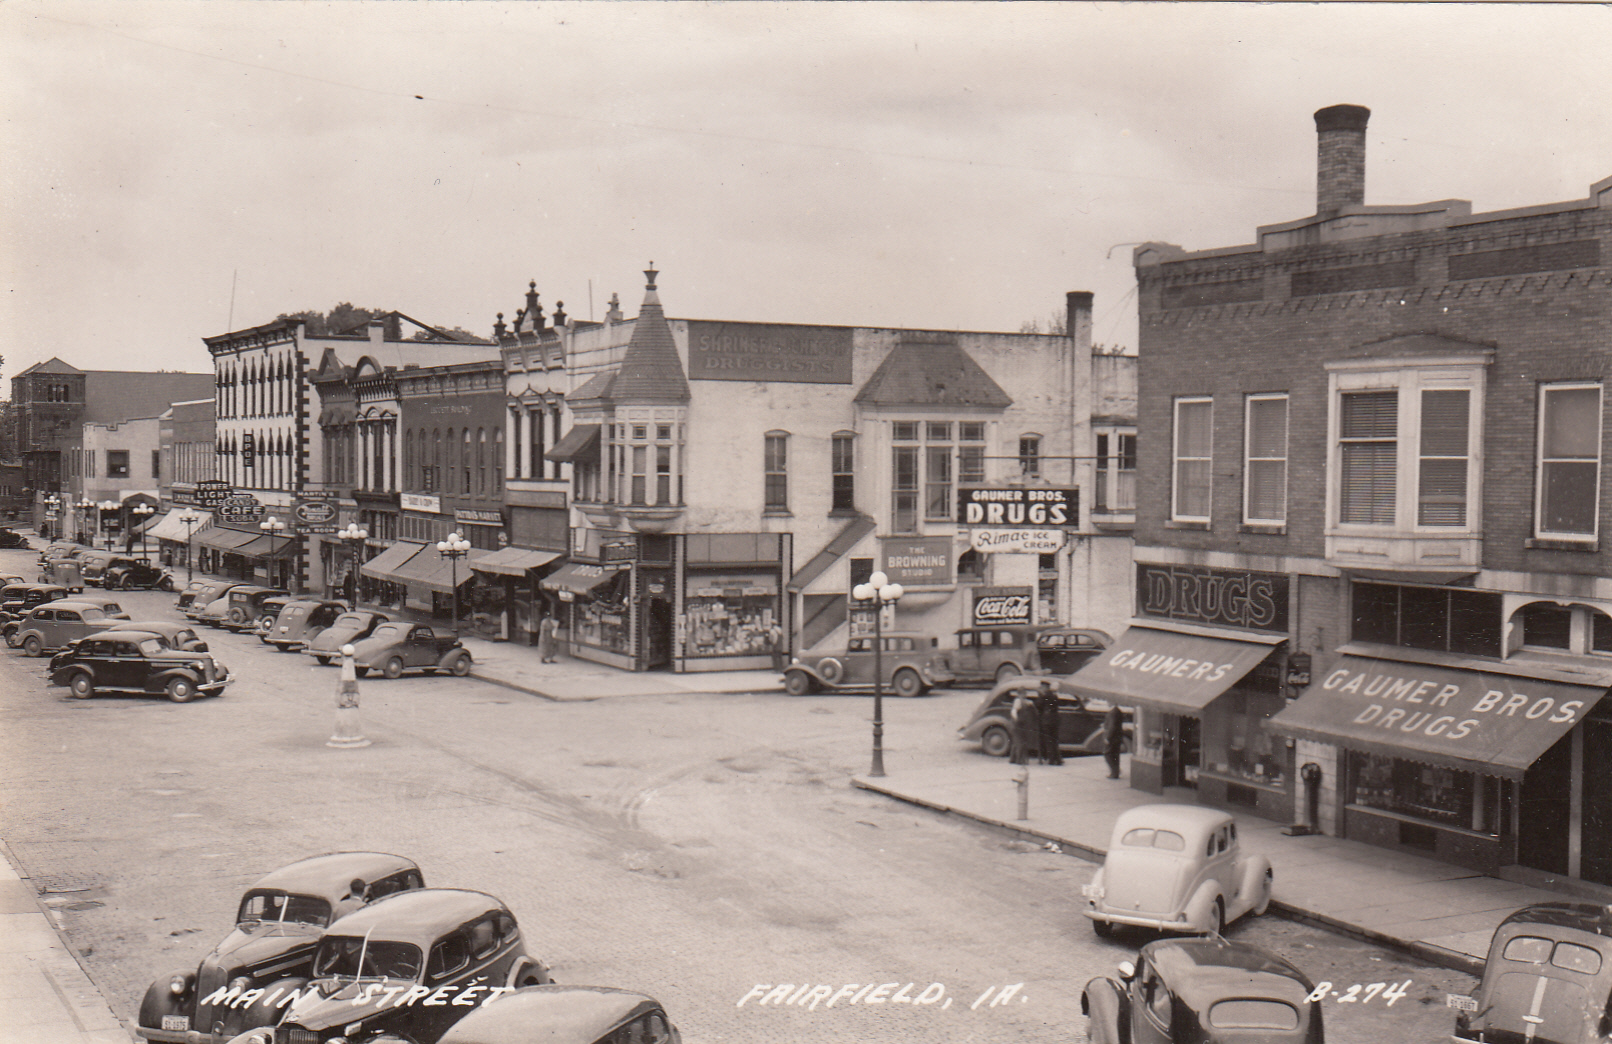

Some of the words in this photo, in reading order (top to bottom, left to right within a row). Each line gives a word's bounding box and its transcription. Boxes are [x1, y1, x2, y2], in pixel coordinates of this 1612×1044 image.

[705, 357, 833, 372] DRUGGISTS
[196, 491, 232, 499] LIGHT
[972, 490, 1022, 501] GAUMER
[1028, 490, 1066, 501] BROS.
[220, 507, 262, 515] CAFE
[966, 503, 1068, 524] DRUGS
[1033, 532, 1049, 540] ICE
[909, 546, 925, 554] THE
[1024, 541, 1057, 549] CREAM
[888, 555, 946, 569] BROWNING
[901, 569, 933, 577] STUDIO
[1146, 570, 1276, 626] DRUGS
[1109, 649, 1233, 681] GAUMERS
[1322, 669, 1460, 708] GAUMER
[1472, 689, 1585, 724] BROS.
[1354, 704, 1480, 740] DRUGS
